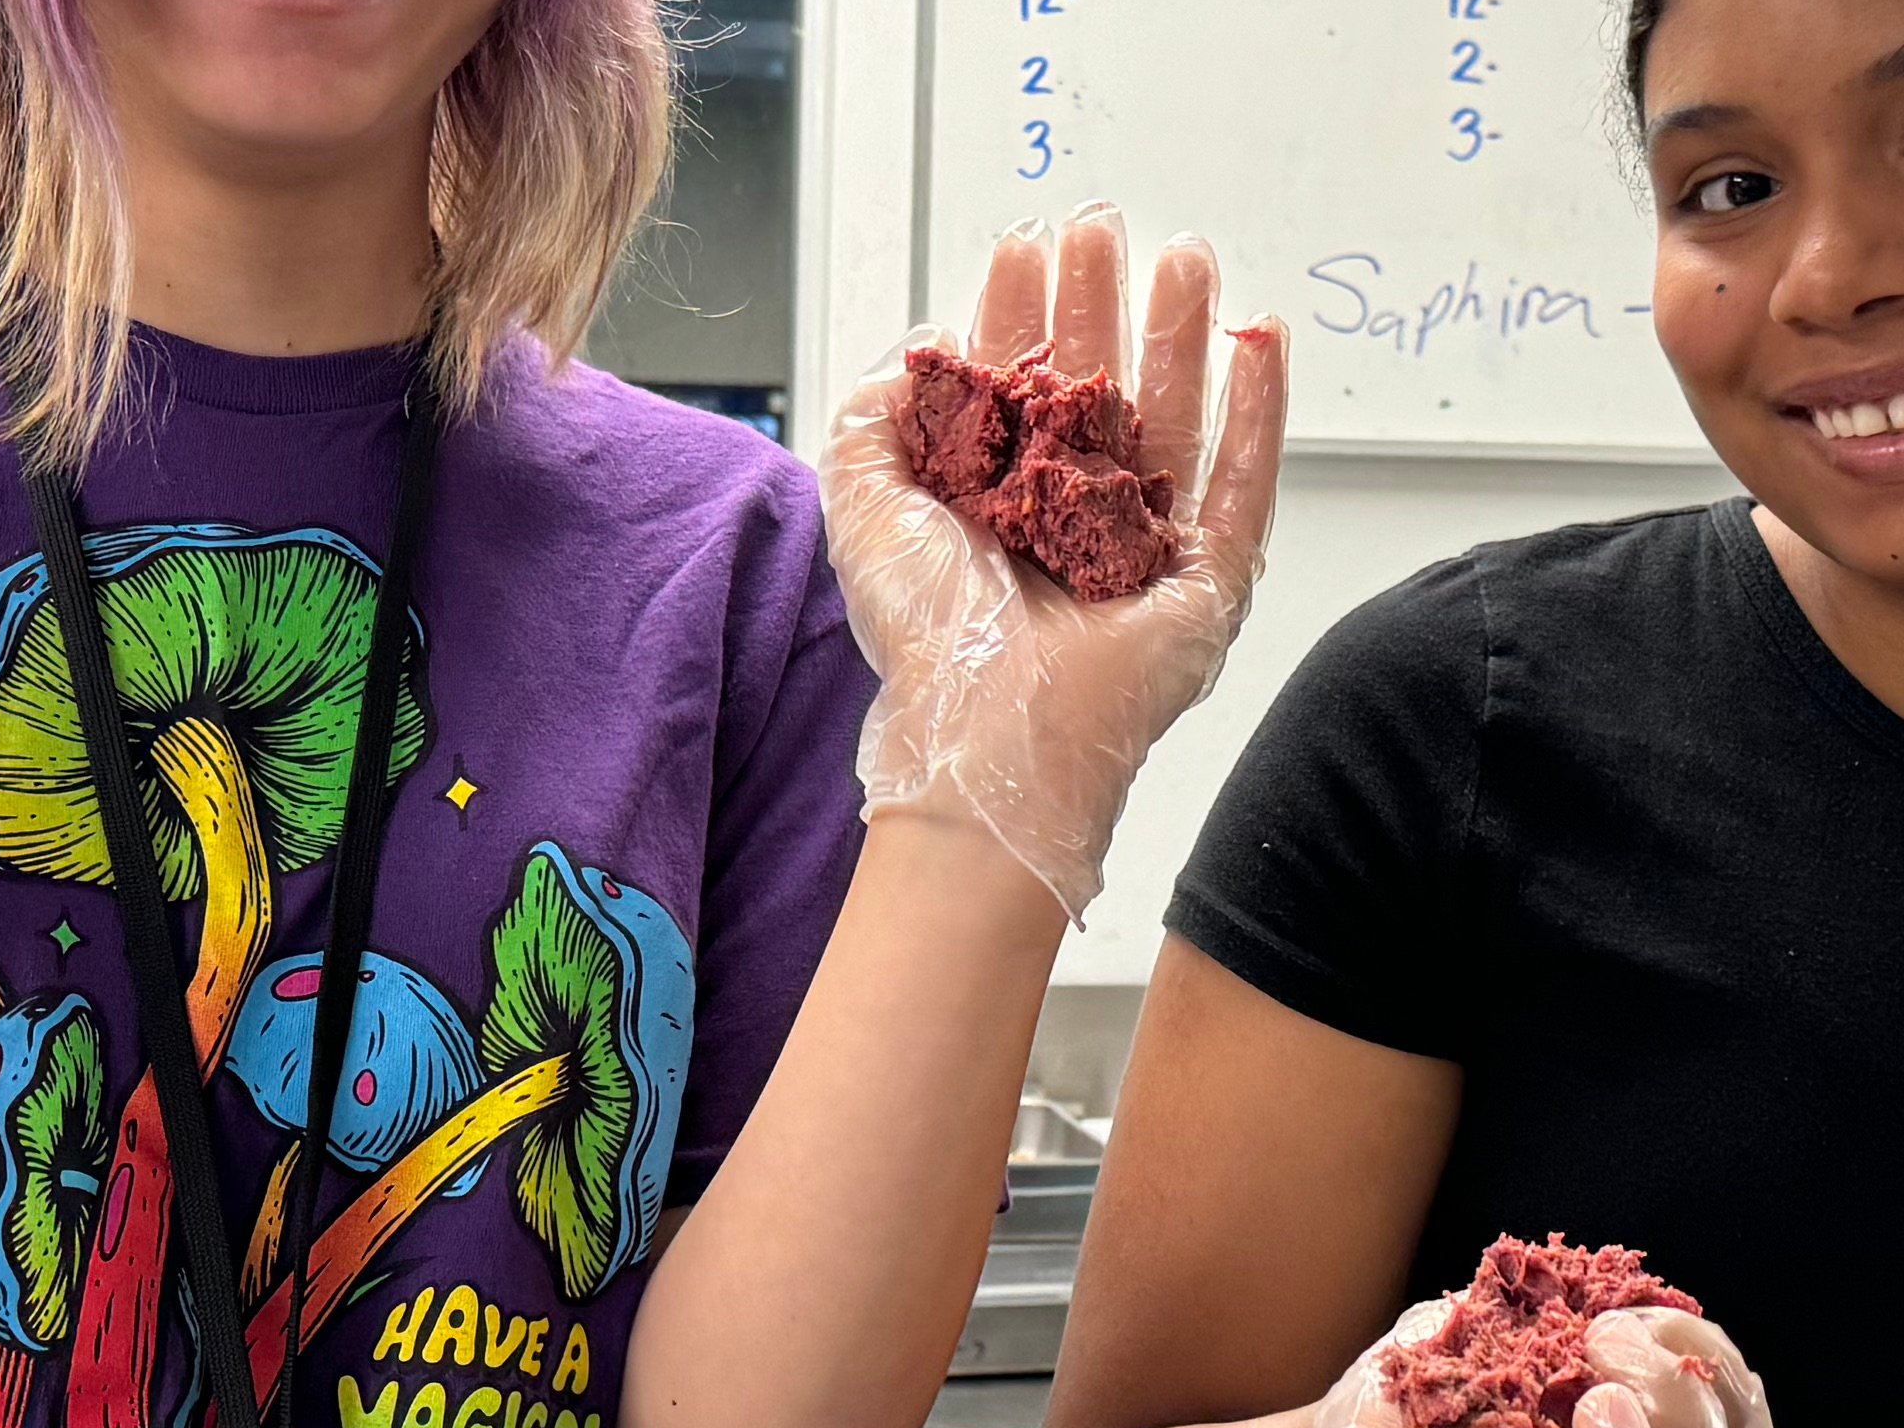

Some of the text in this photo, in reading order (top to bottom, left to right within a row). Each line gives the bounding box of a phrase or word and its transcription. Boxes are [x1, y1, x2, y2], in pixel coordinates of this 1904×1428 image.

[1306, 252, 1604, 359] Saphira
[372, 1284, 590, 1395] HAVE A
